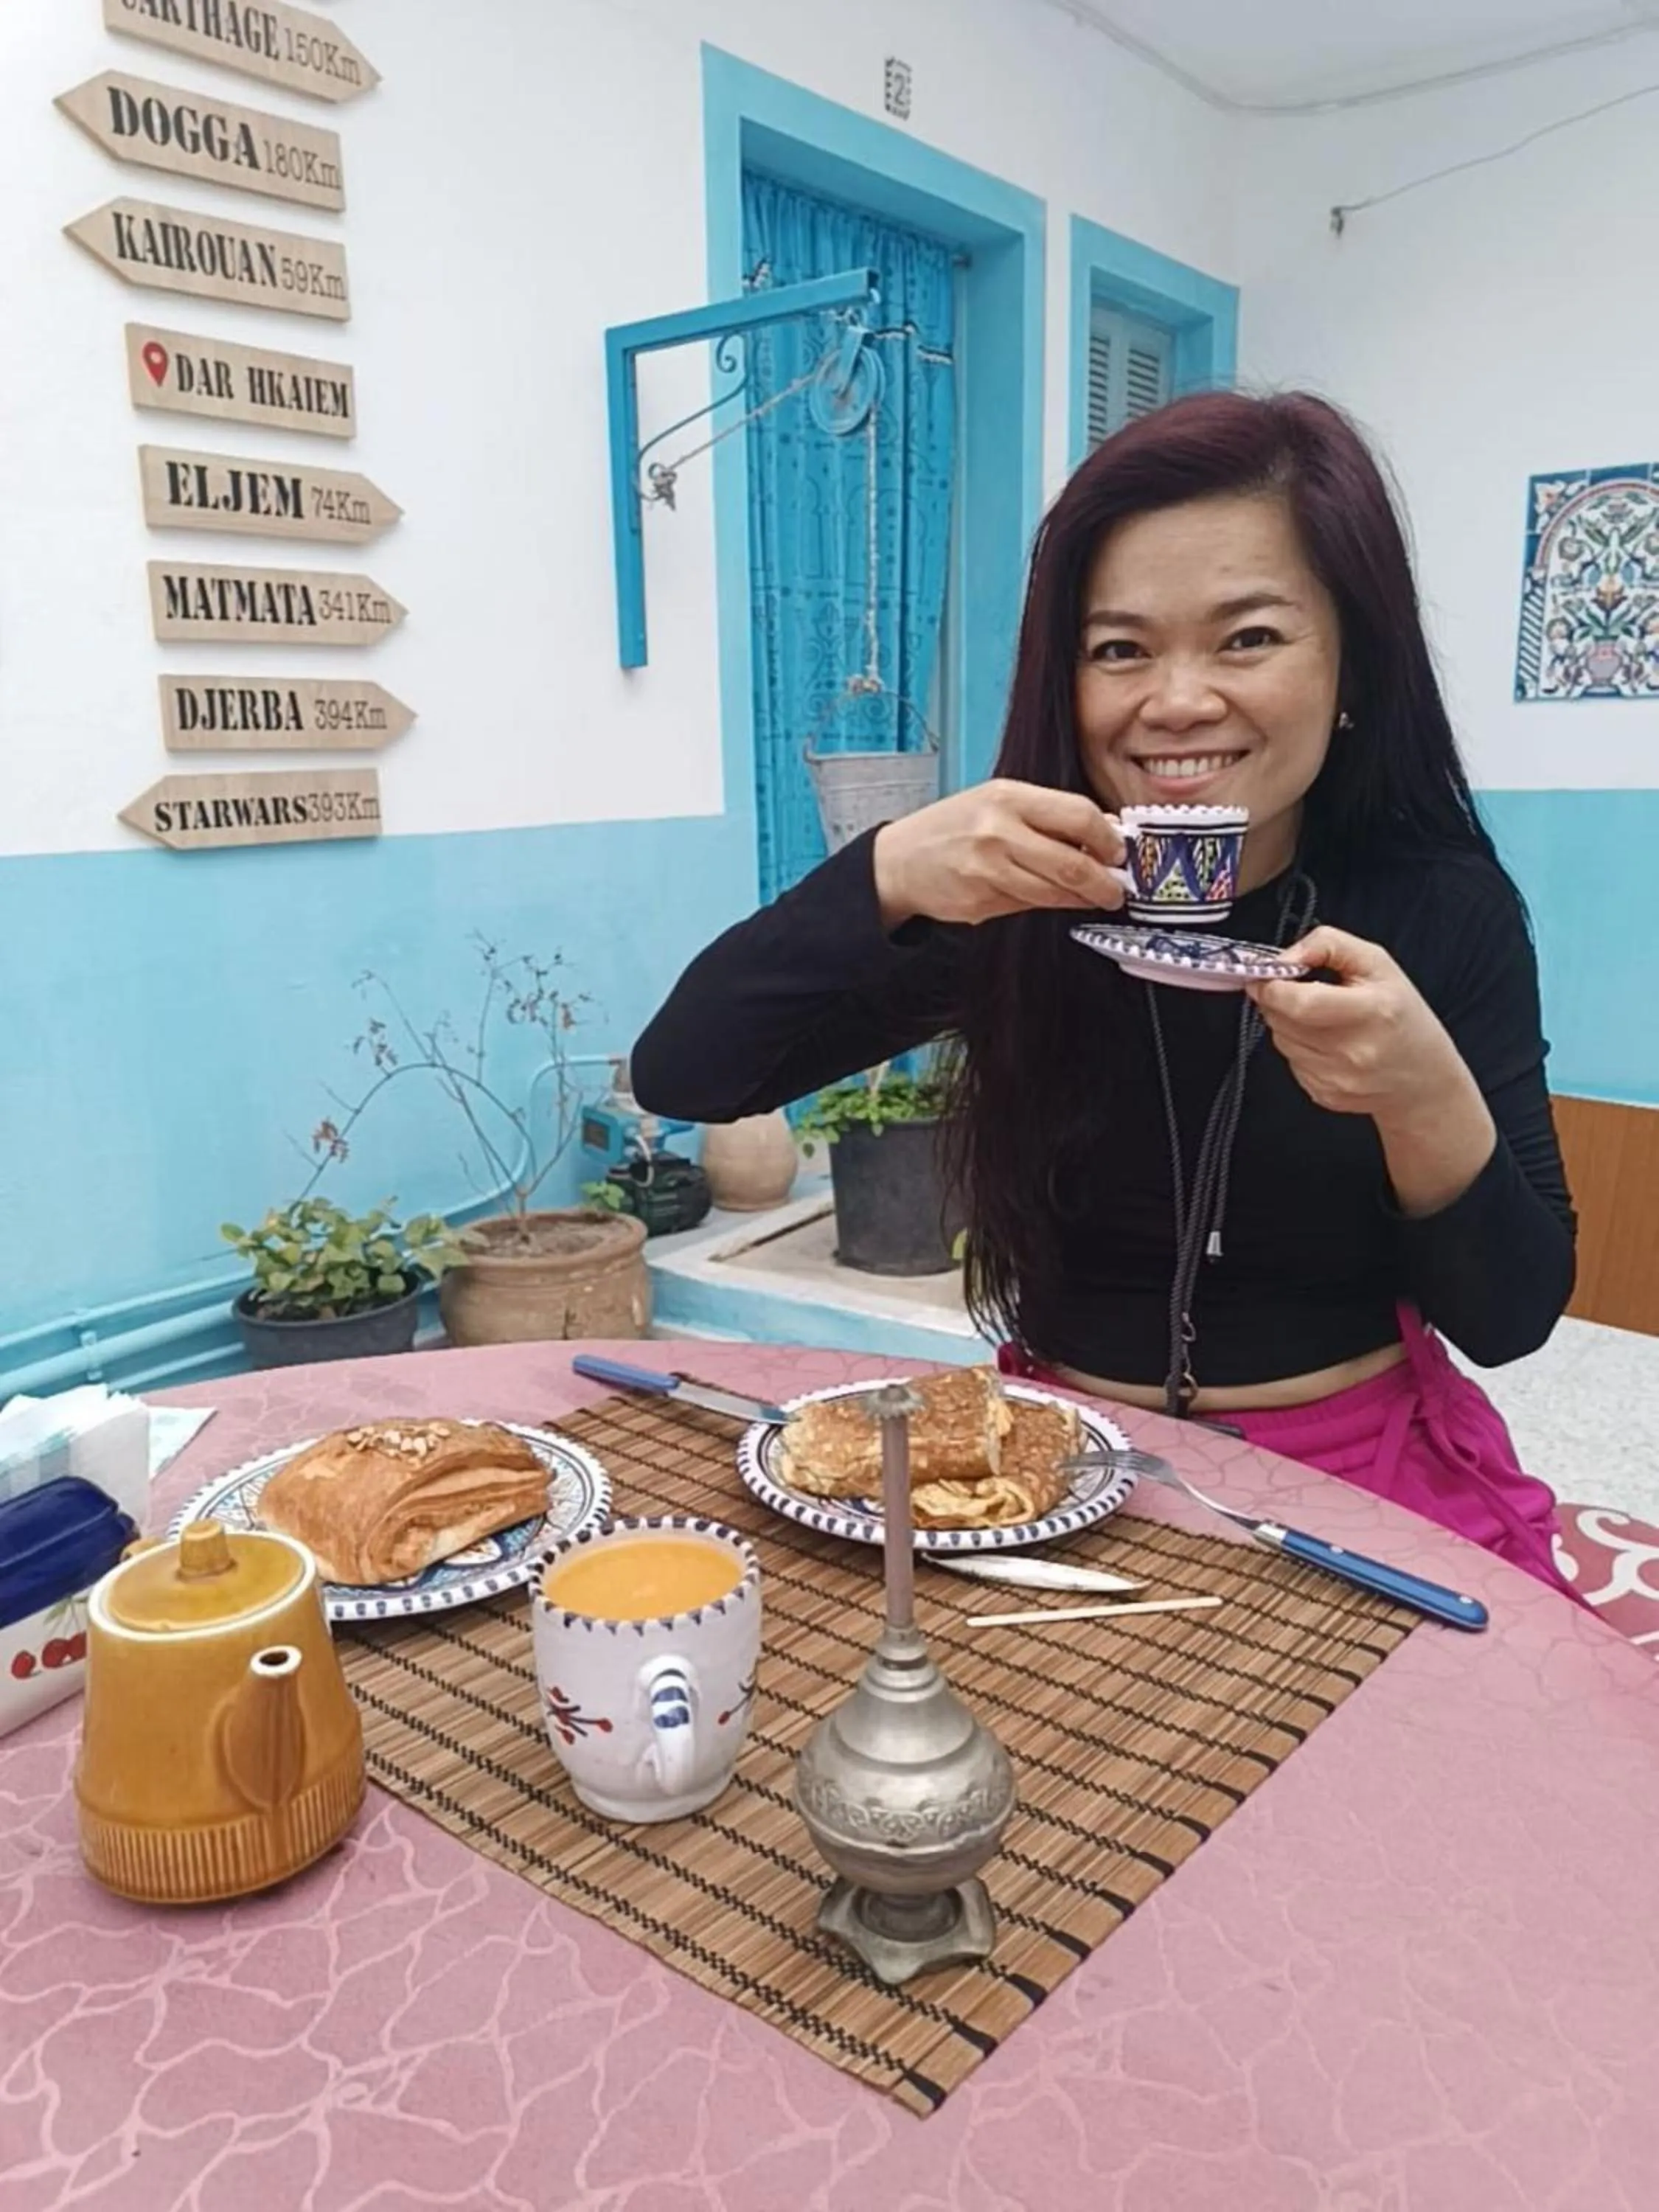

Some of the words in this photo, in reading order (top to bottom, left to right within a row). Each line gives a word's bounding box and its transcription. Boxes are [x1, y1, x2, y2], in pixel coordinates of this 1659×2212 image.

[121, 0, 279, 60] RTHAGE
[284, 27, 362, 86] 150Km
[106, 86, 261, 170] DOGGA
[263, 139, 342, 191] 180Km
[112, 211, 278, 288] KAIROUAN
[280, 257, 347, 302] 59Km
[175, 352, 234, 400] DAR
[247, 366, 350, 419] HKAIEM
[165, 460, 305, 519] ELJEM
[310, 485, 372, 525] 74Km
[163, 574, 318, 626] MATMATA
[318, 589, 392, 624] 341Km
[175, 687, 305, 731] DJERBA
[314, 699, 388, 730] 394Km
[154, 796, 308, 832] STARWARS
